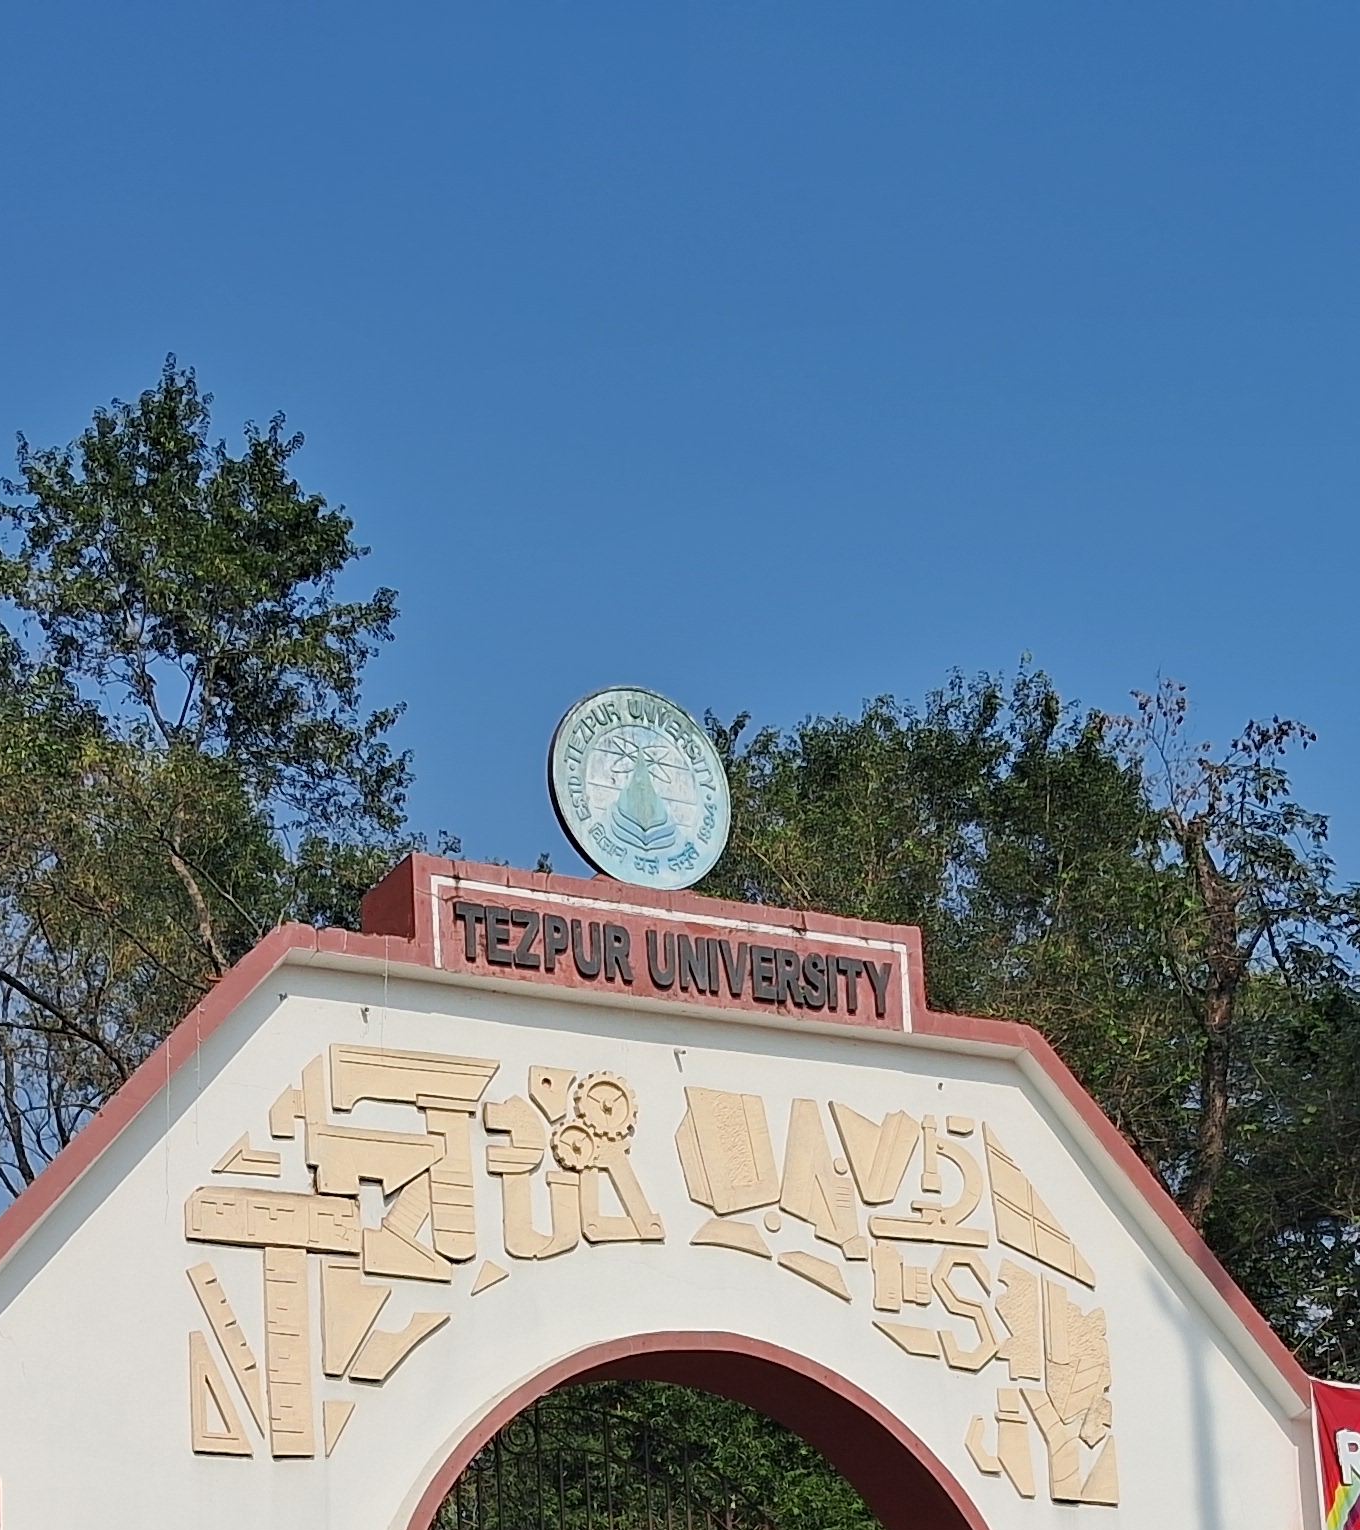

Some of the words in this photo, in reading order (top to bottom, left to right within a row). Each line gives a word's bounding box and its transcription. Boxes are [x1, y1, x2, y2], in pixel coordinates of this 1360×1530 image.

[563, 701, 622, 764] TEZPUR
[626, 697, 718, 792] UNIVERSITY
[453, 901, 636, 985] TEZPUR
[645, 928, 893, 1020] UNIVERSITY
